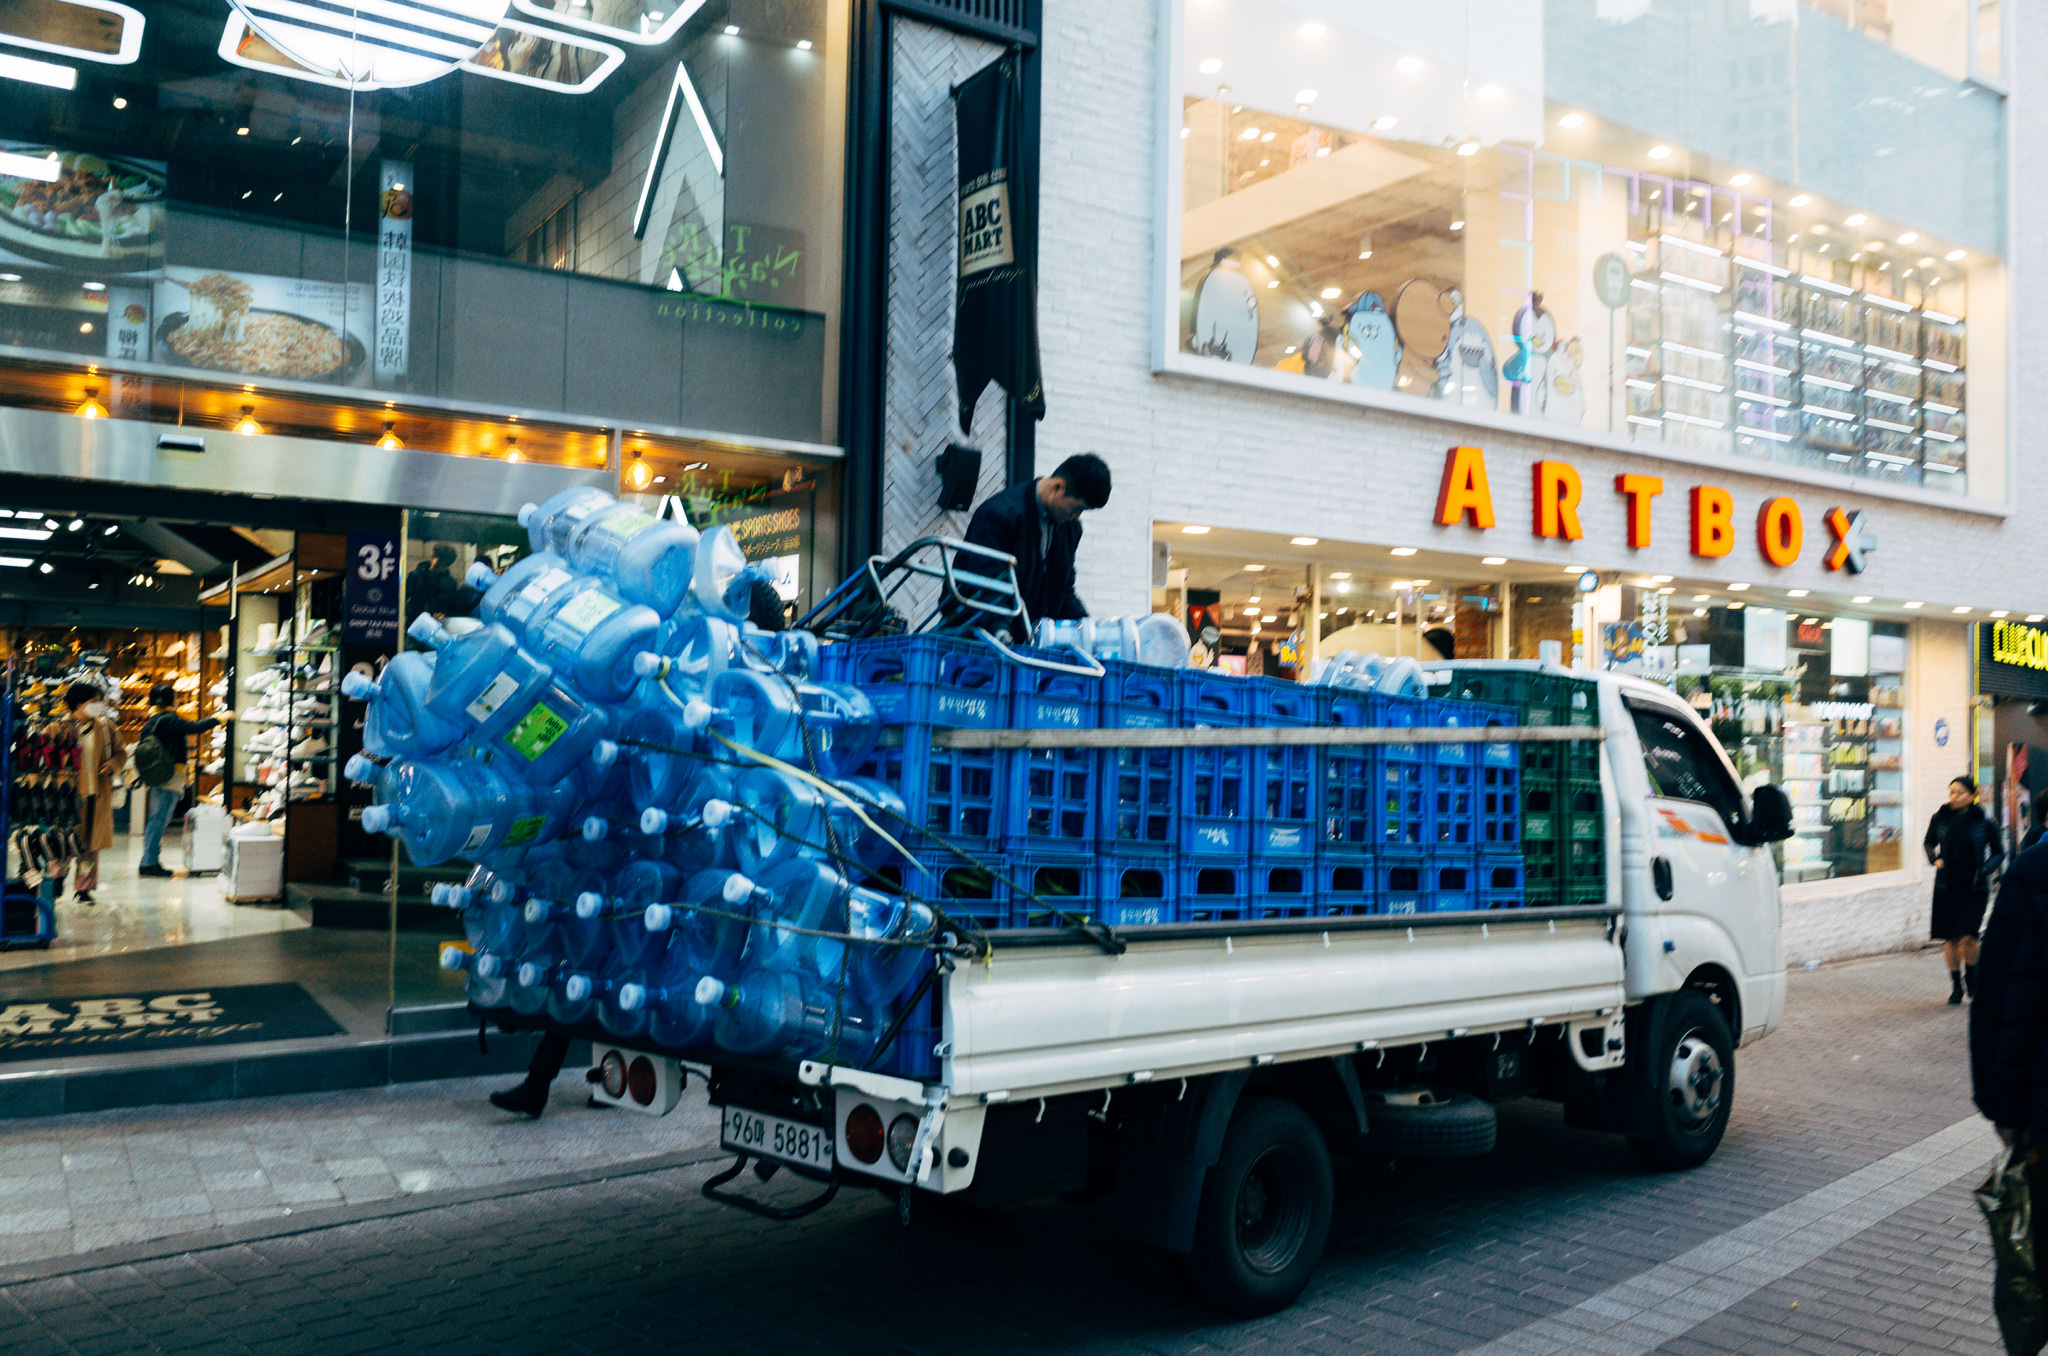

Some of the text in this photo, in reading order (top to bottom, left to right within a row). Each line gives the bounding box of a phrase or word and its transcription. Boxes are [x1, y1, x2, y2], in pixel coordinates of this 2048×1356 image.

[963, 196, 1002, 238] ABC
[963, 226, 1004, 258] MART
[1433, 445, 1877, 575] ARTBOX
[0, 992, 218, 1023] ABC
[774, 1121, 821, 1163] 5881
